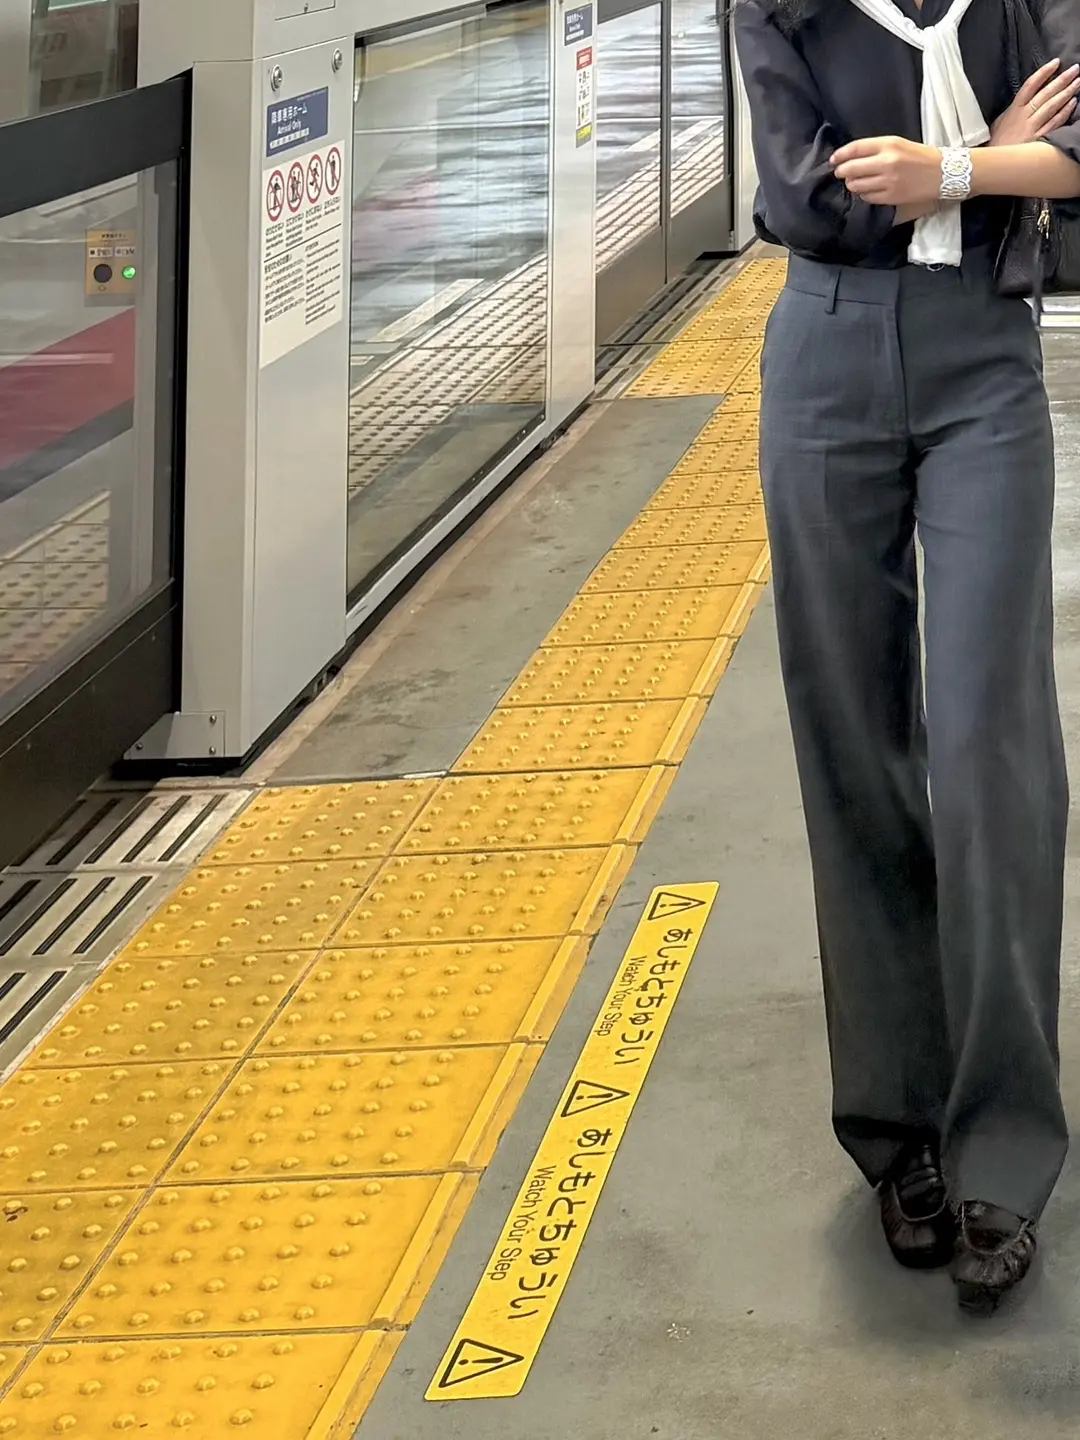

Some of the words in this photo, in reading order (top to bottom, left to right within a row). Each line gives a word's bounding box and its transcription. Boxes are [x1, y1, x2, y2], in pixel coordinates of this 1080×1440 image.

[618, 955, 648, 987] Watch
[608, 988, 632, 1010] Your
[613, 928, 694, 1065] あしもとちゅうい
[593, 1012, 622, 1037] Step
[523, 1165, 558, 1208] Watch
[507, 1128, 613, 1319] あしもとちゅうい
[507, 1210, 538, 1244] Your
[486, 1247, 523, 1281] Step
